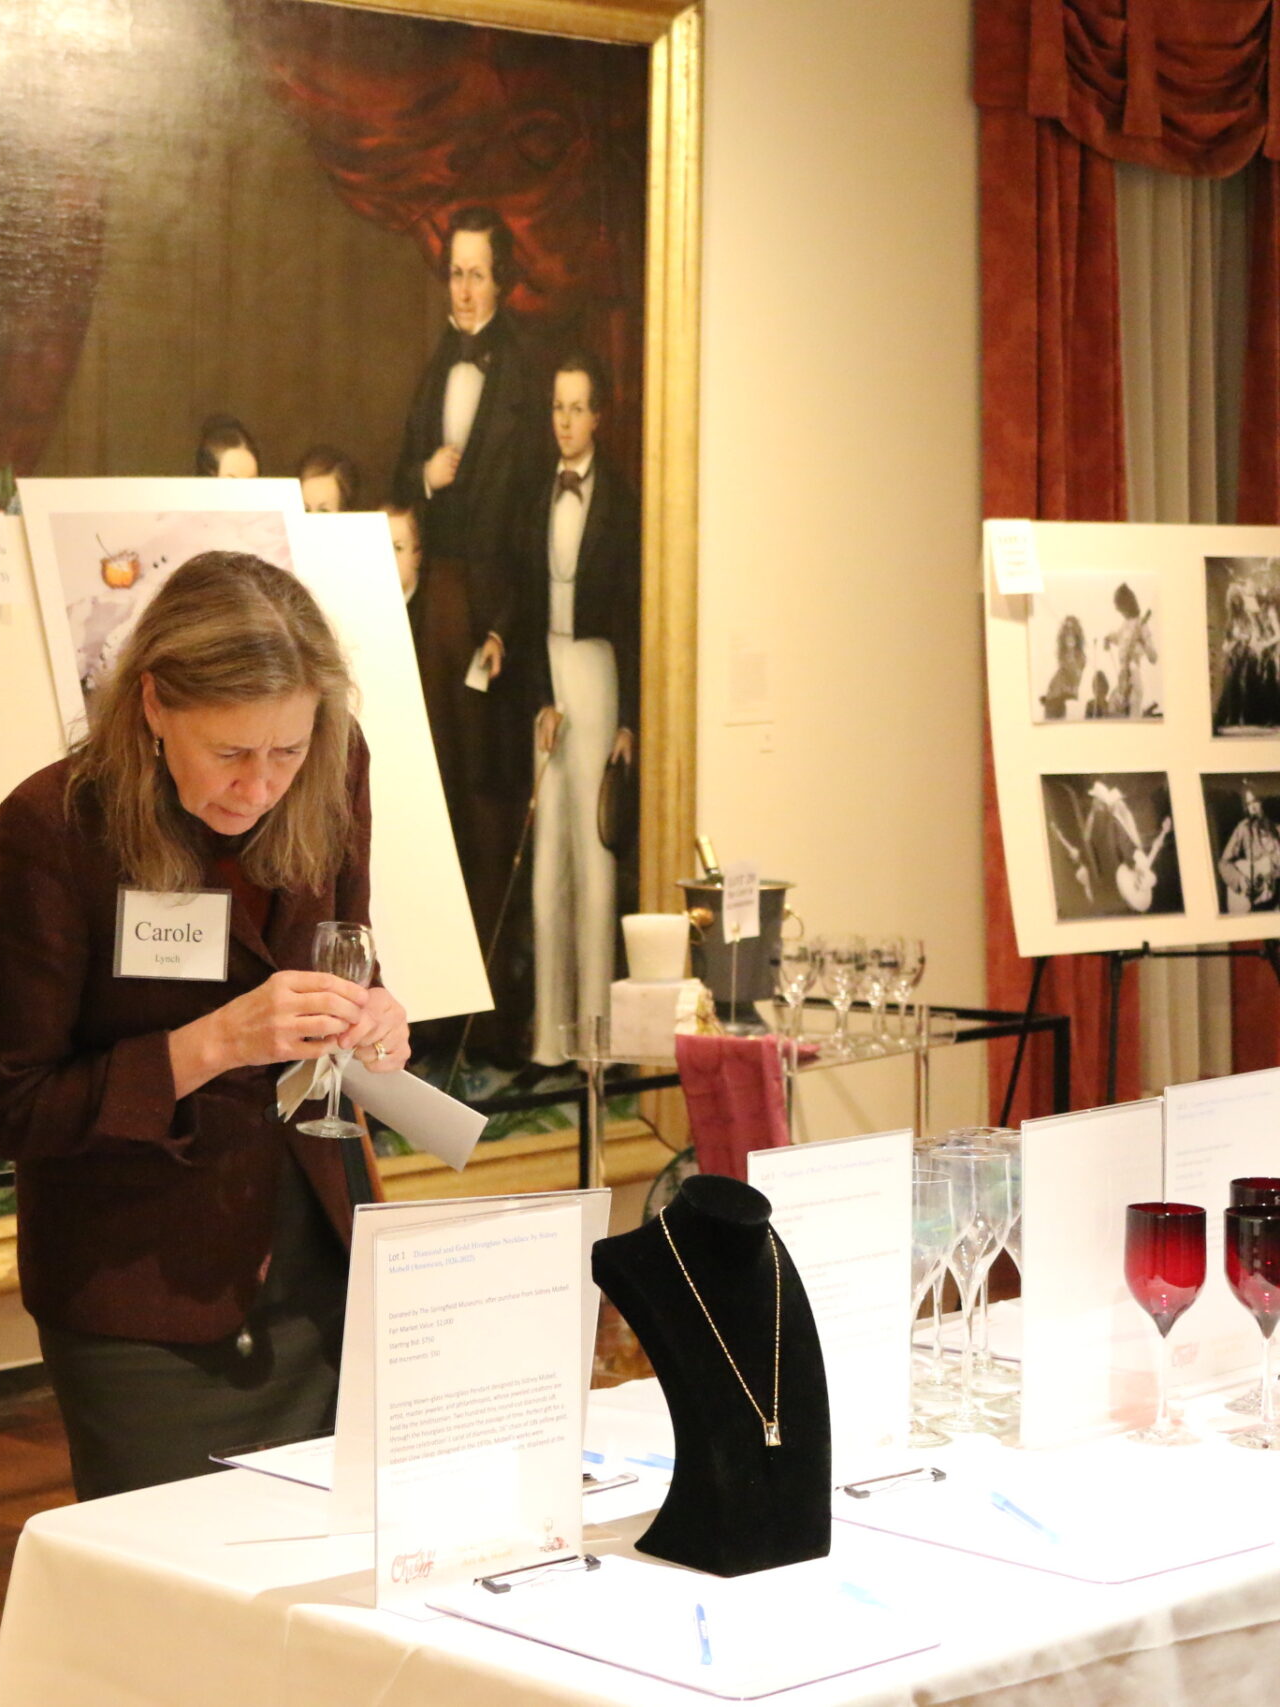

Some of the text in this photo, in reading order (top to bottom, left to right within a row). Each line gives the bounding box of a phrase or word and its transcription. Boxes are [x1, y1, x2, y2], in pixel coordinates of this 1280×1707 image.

[135, 921, 203, 943] Carole
[155, 953, 181, 965] Lynch
[388, 1252, 400, 1263] Lot
